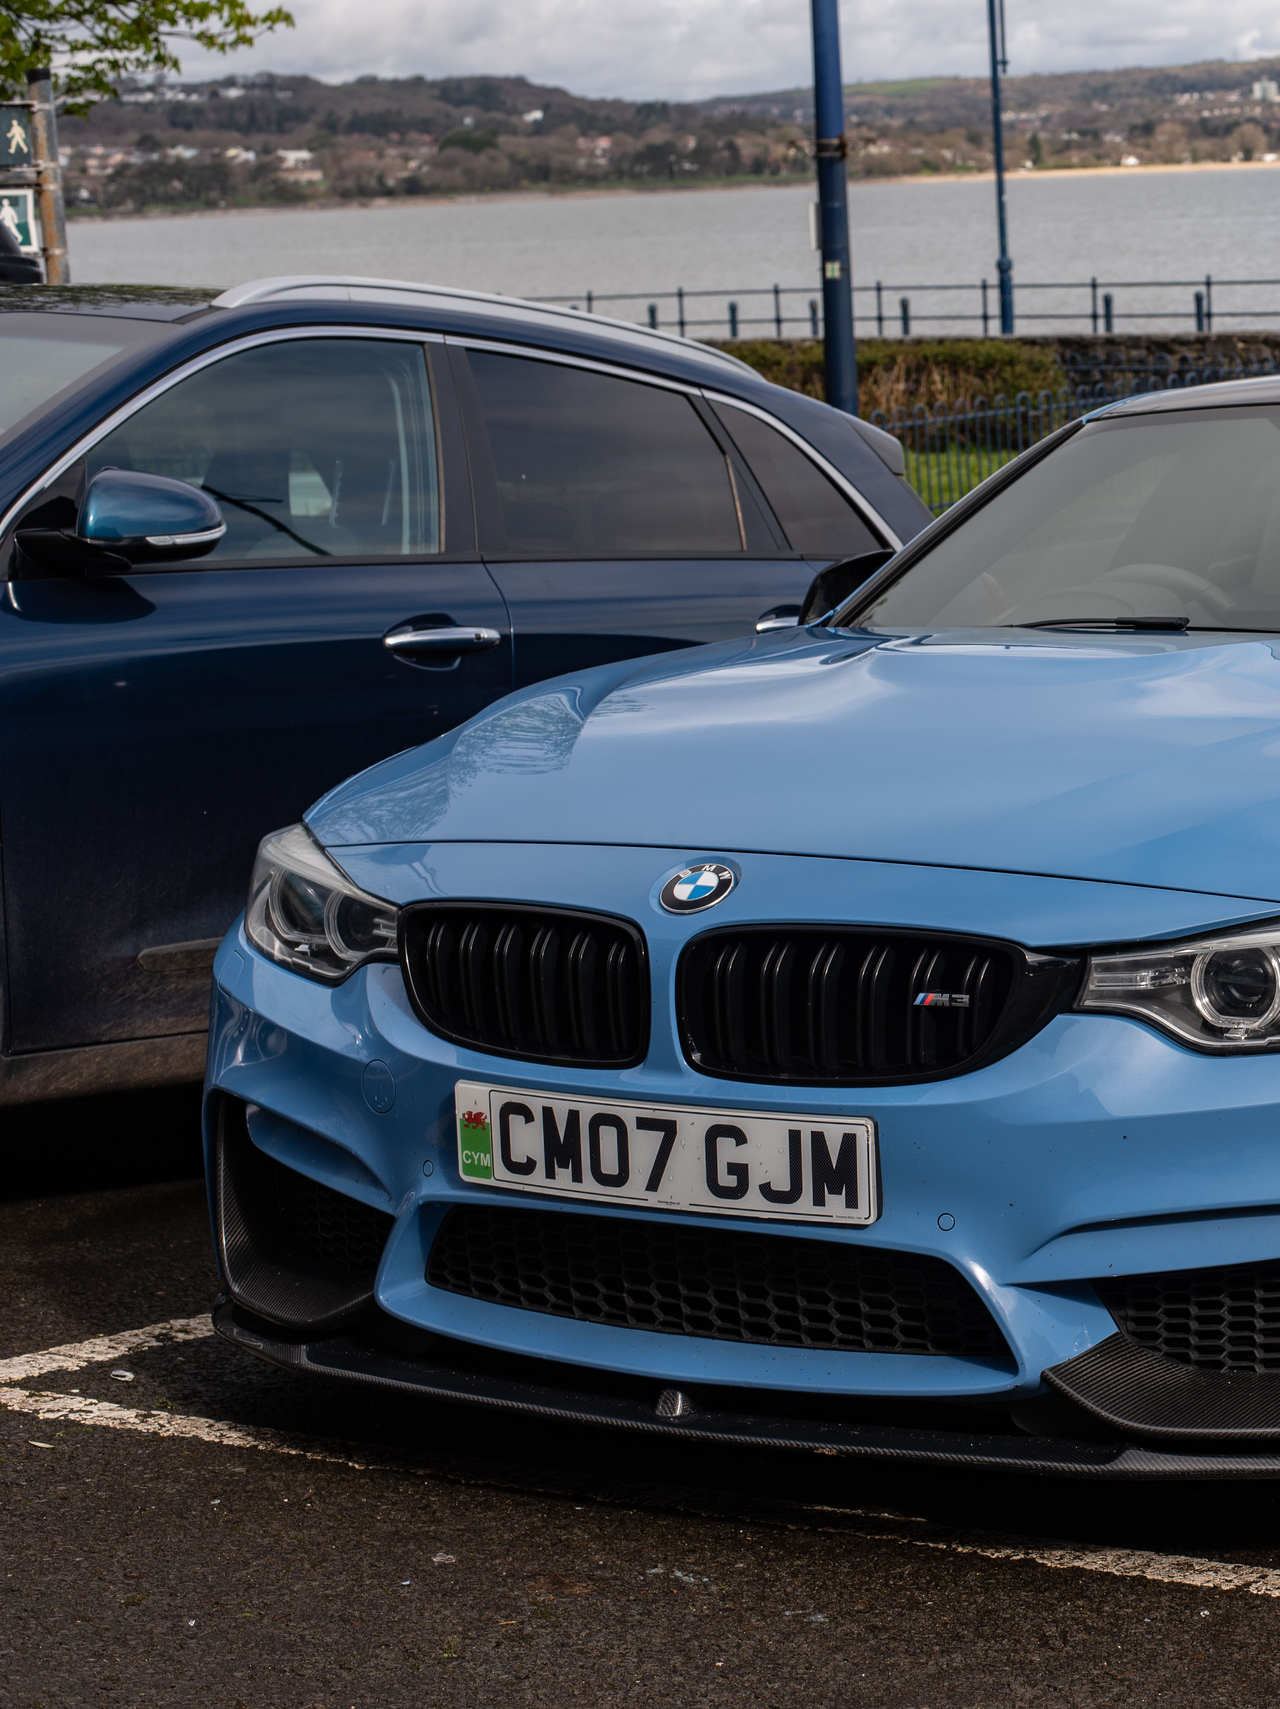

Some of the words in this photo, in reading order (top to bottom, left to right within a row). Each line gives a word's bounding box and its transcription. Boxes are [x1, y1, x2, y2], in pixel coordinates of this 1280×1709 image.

[678, 863, 732, 880] BMW
[928, 993, 970, 1007] M3
[462, 1150, 491, 1167] CYM
[499, 1101, 677, 1193] CM07
[704, 1123, 859, 1210] GJM
